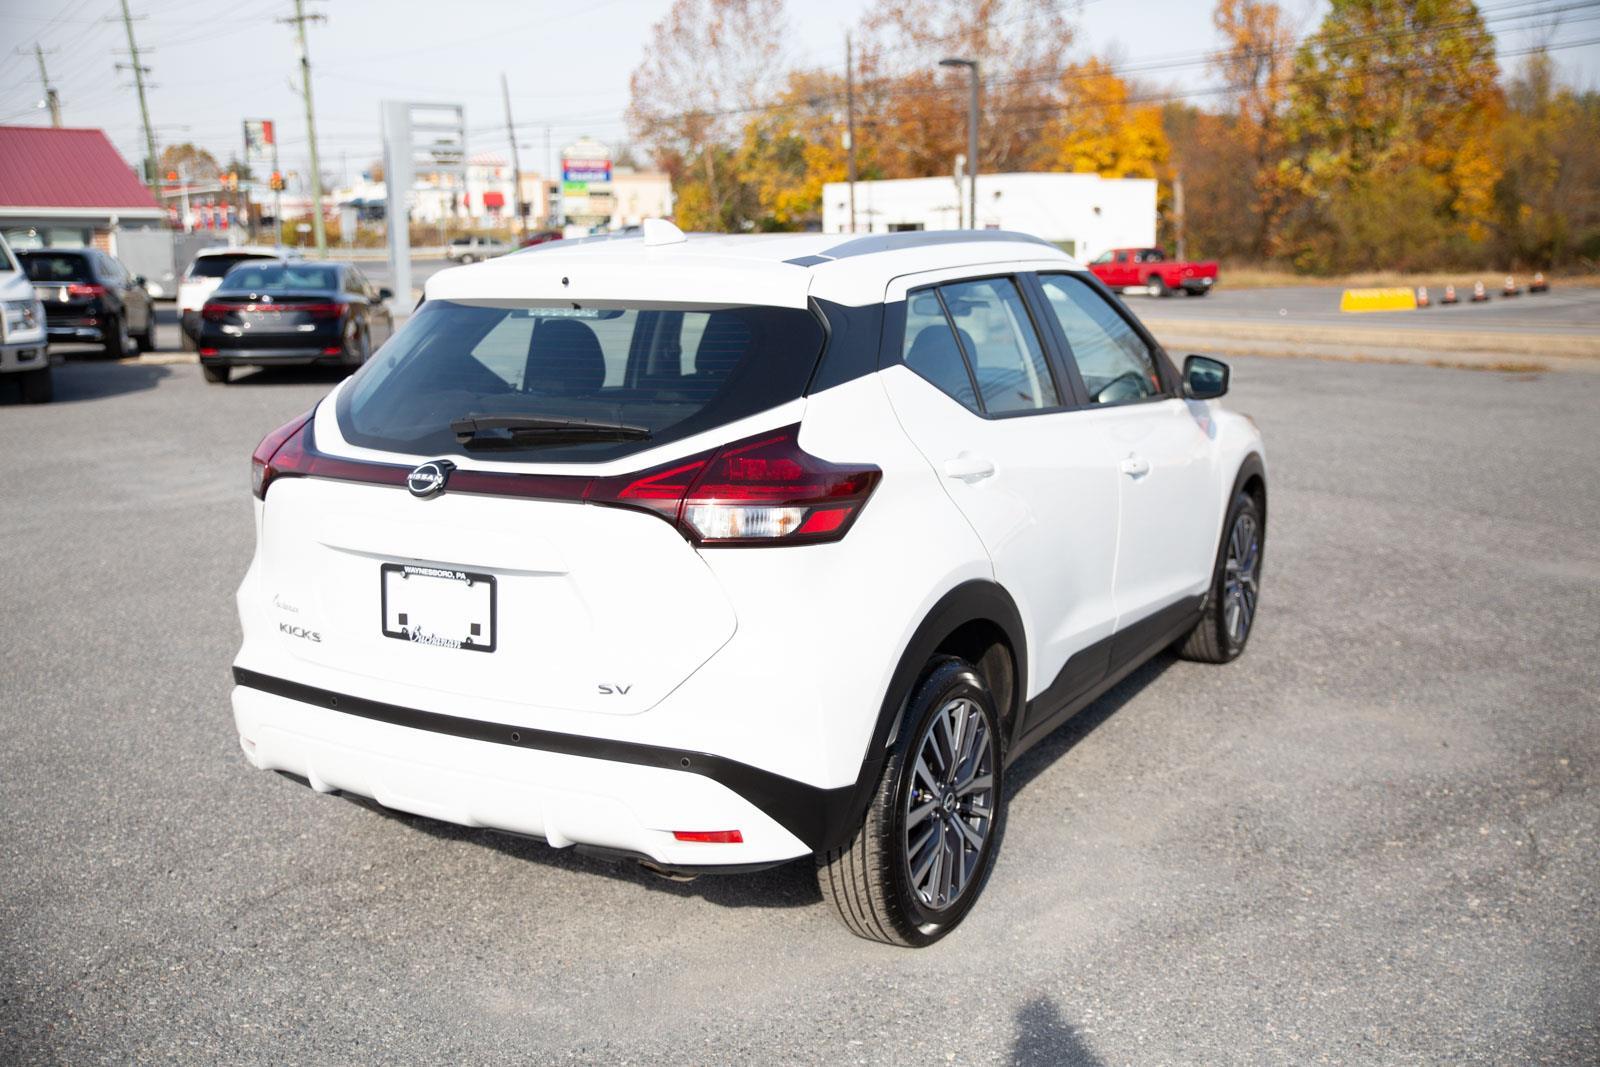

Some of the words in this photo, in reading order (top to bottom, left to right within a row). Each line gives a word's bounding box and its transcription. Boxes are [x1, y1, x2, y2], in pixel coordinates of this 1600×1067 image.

[407, 473, 444, 484] NISSAN
[456, 571, 467, 580] PA
[279, 622, 321, 643] KICKS
[598, 681, 632, 694] SV
